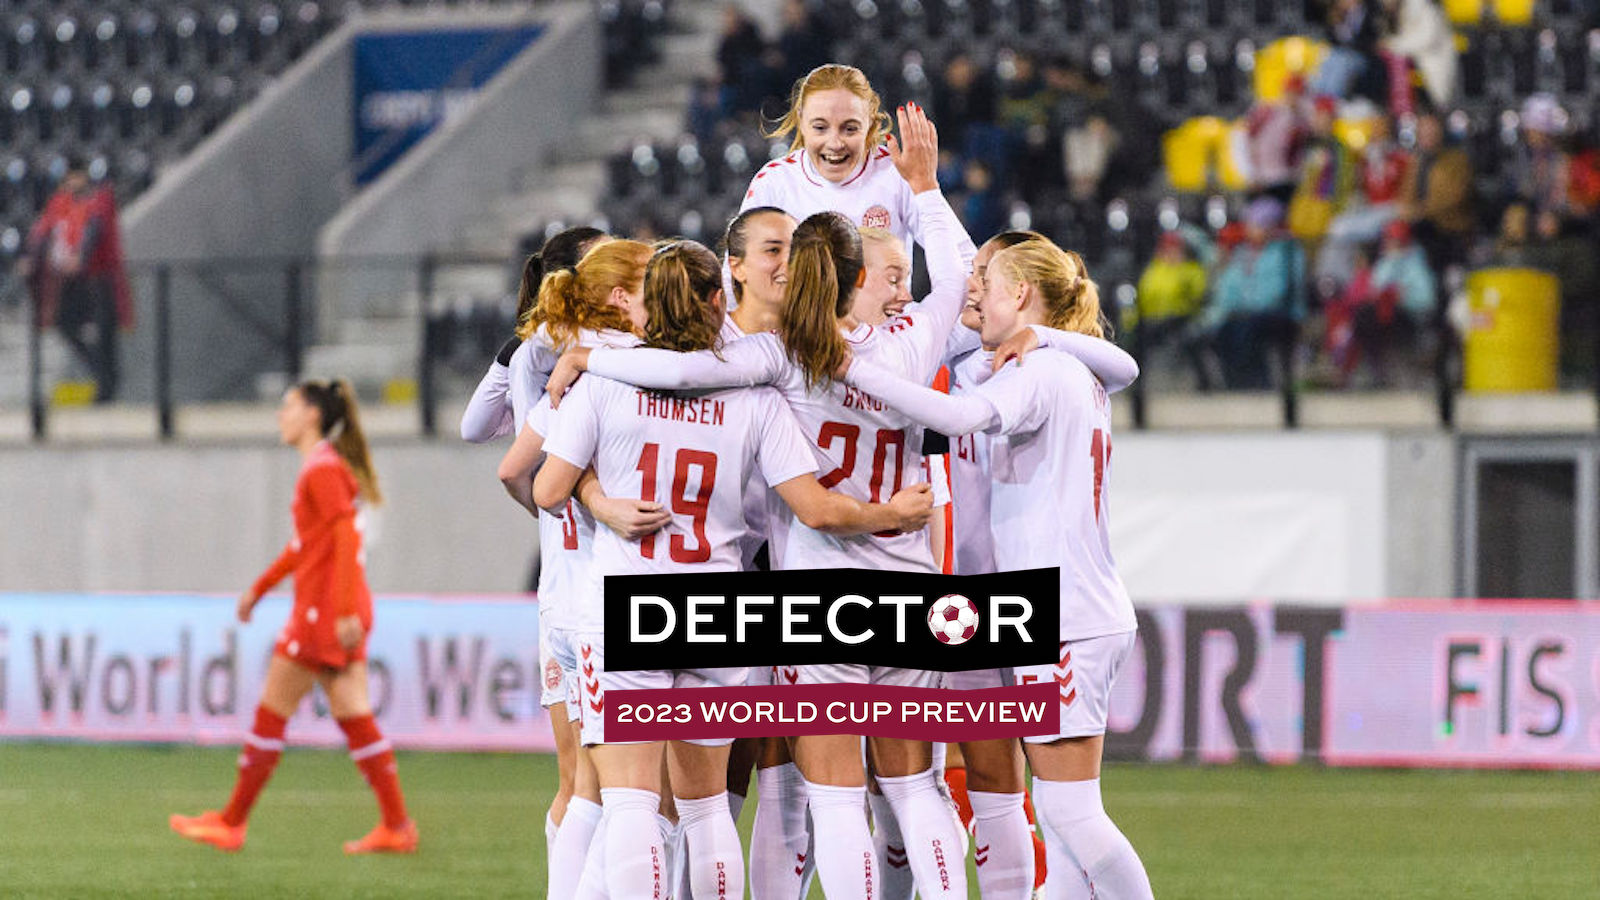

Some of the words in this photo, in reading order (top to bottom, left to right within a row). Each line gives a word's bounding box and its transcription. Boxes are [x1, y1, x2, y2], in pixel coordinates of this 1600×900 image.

[636, 390, 725, 425] THOMSEN
[636, 443, 718, 563] 19
[817, 421, 905, 537] 20
[32, 630, 237, 716] World
[1448, 642, 1564, 737] FIS
[651, 846, 660, 900] DANMAR
